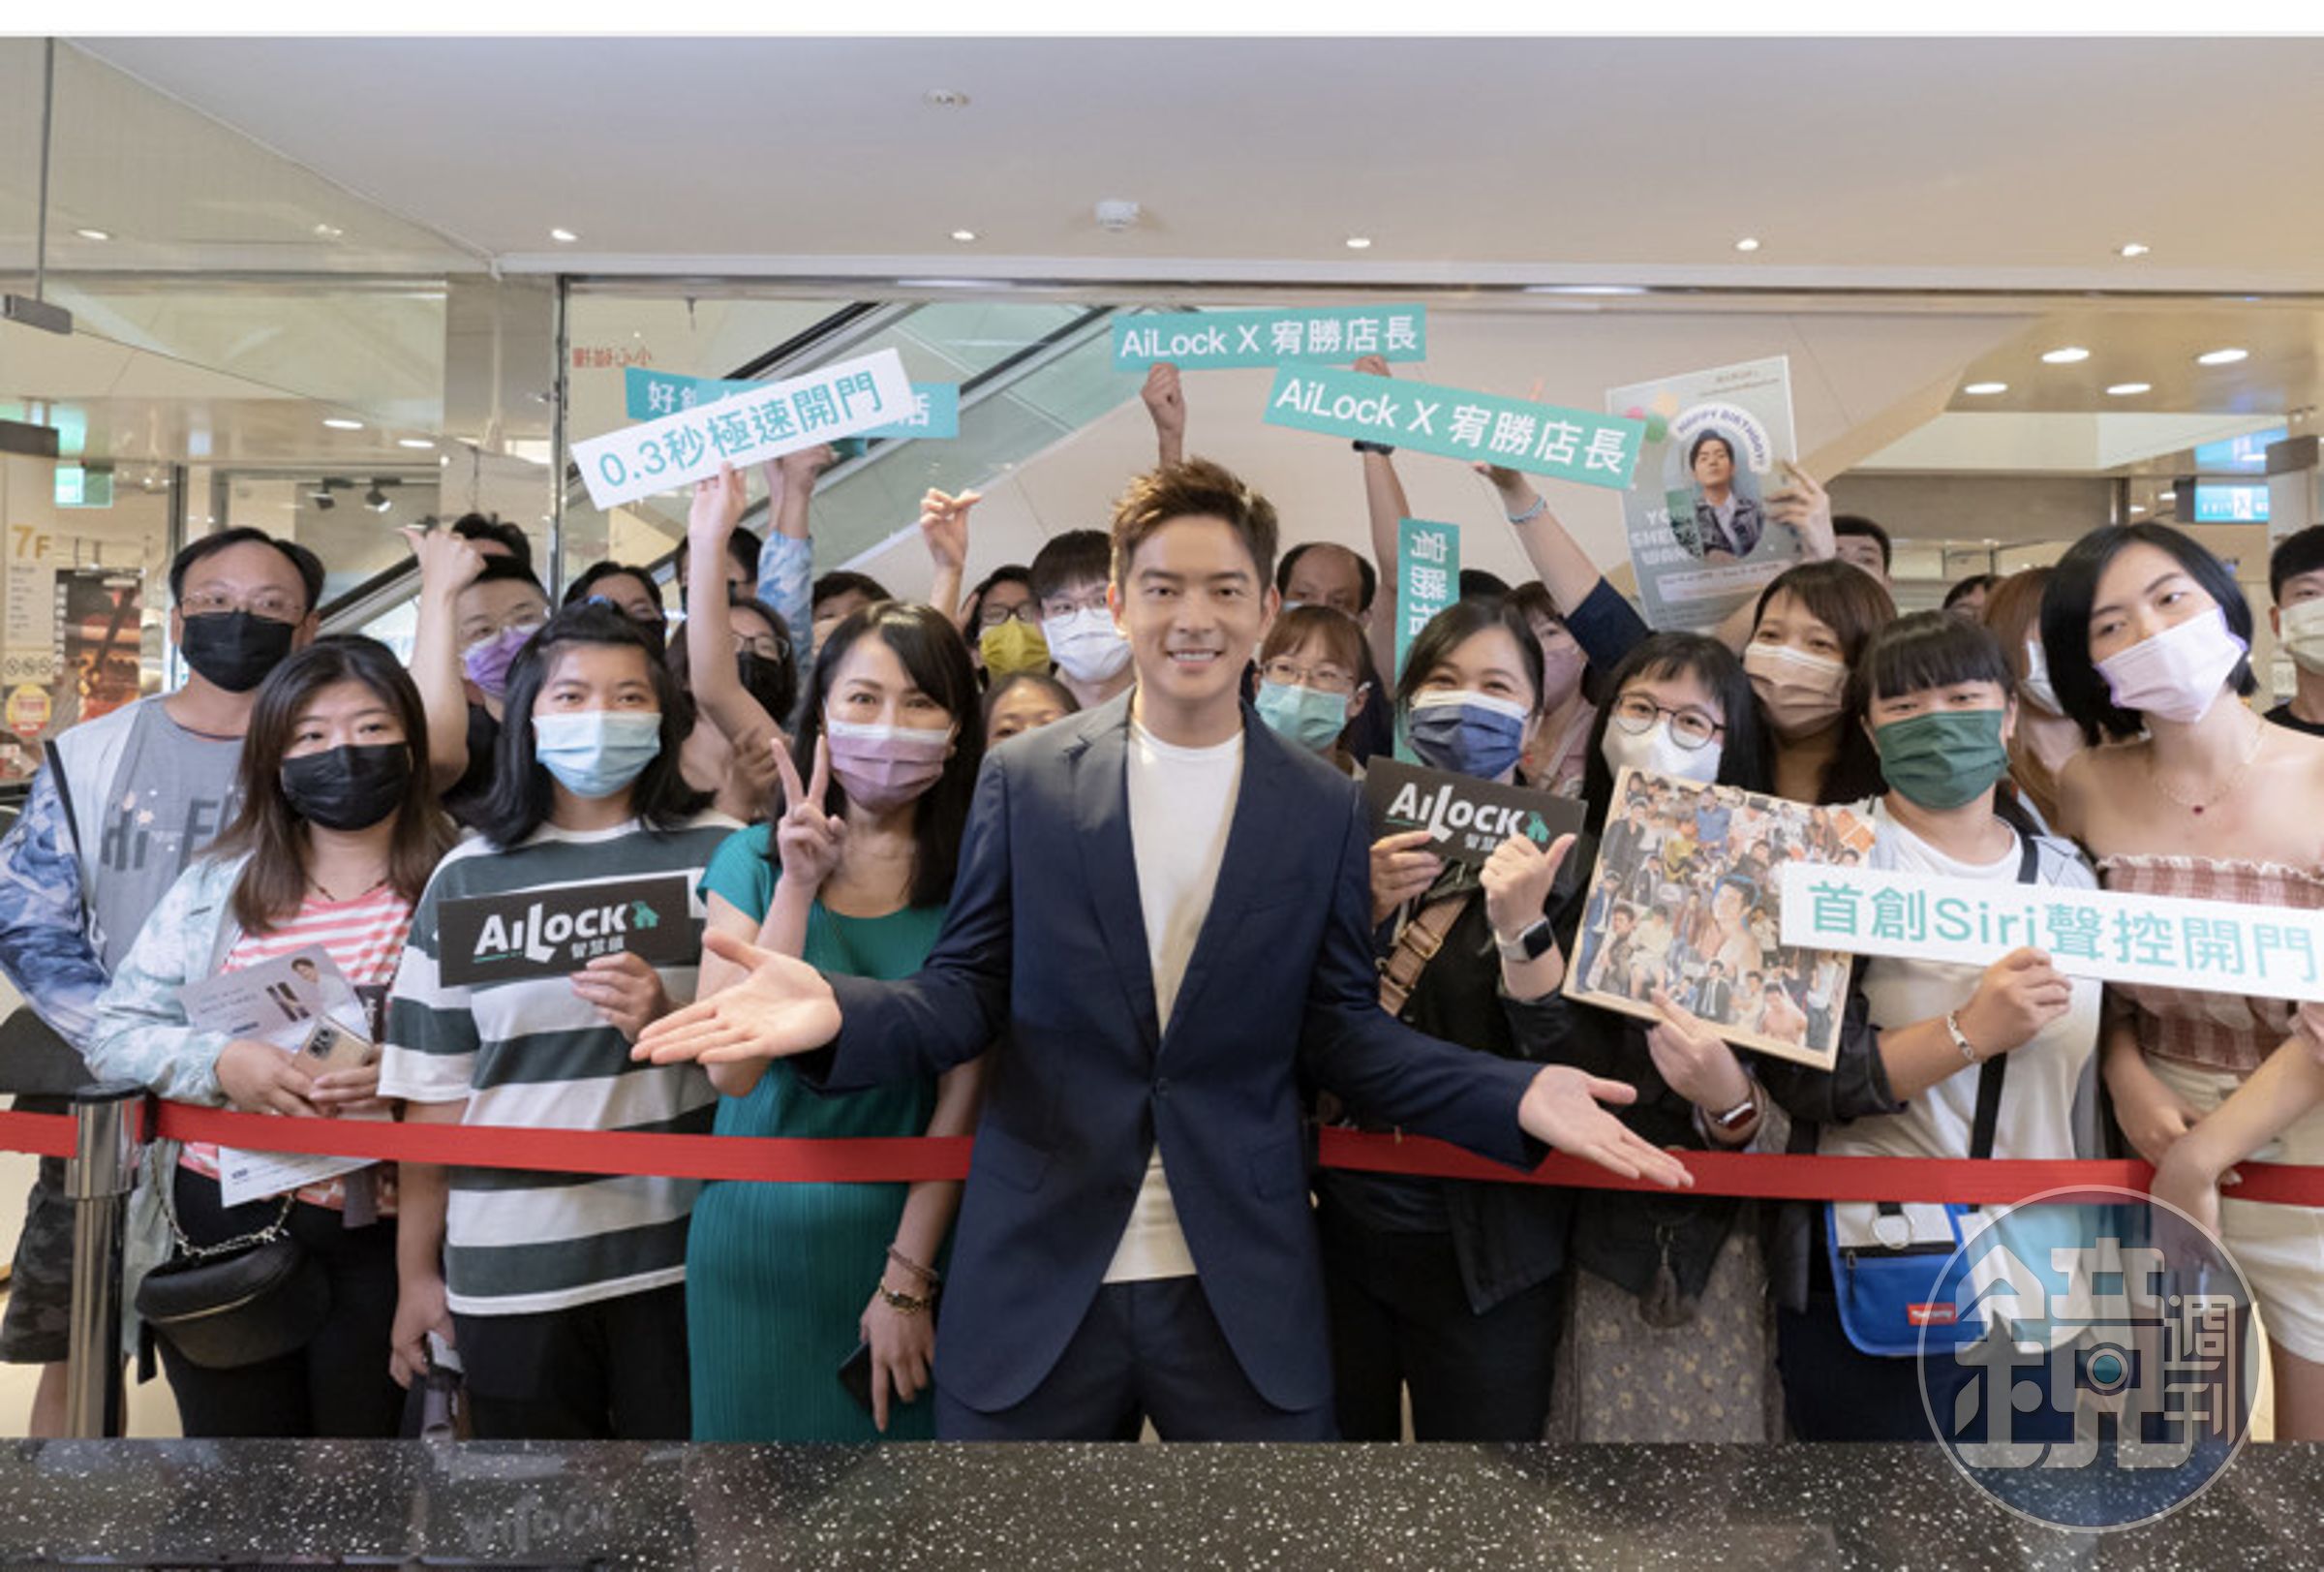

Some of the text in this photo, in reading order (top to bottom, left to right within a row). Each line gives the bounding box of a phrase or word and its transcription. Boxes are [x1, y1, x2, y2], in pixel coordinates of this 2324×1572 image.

[1120, 315, 1418, 358] AiLock X 宥勝店長
[598, 370, 883, 487] 0.3秒極速開門
[1274, 378, 1629, 474] AiLock X 宥勝店長
[12, 524, 51, 559] 7F
[1808, 879, 2318, 984] 首創Siri聲控開門
